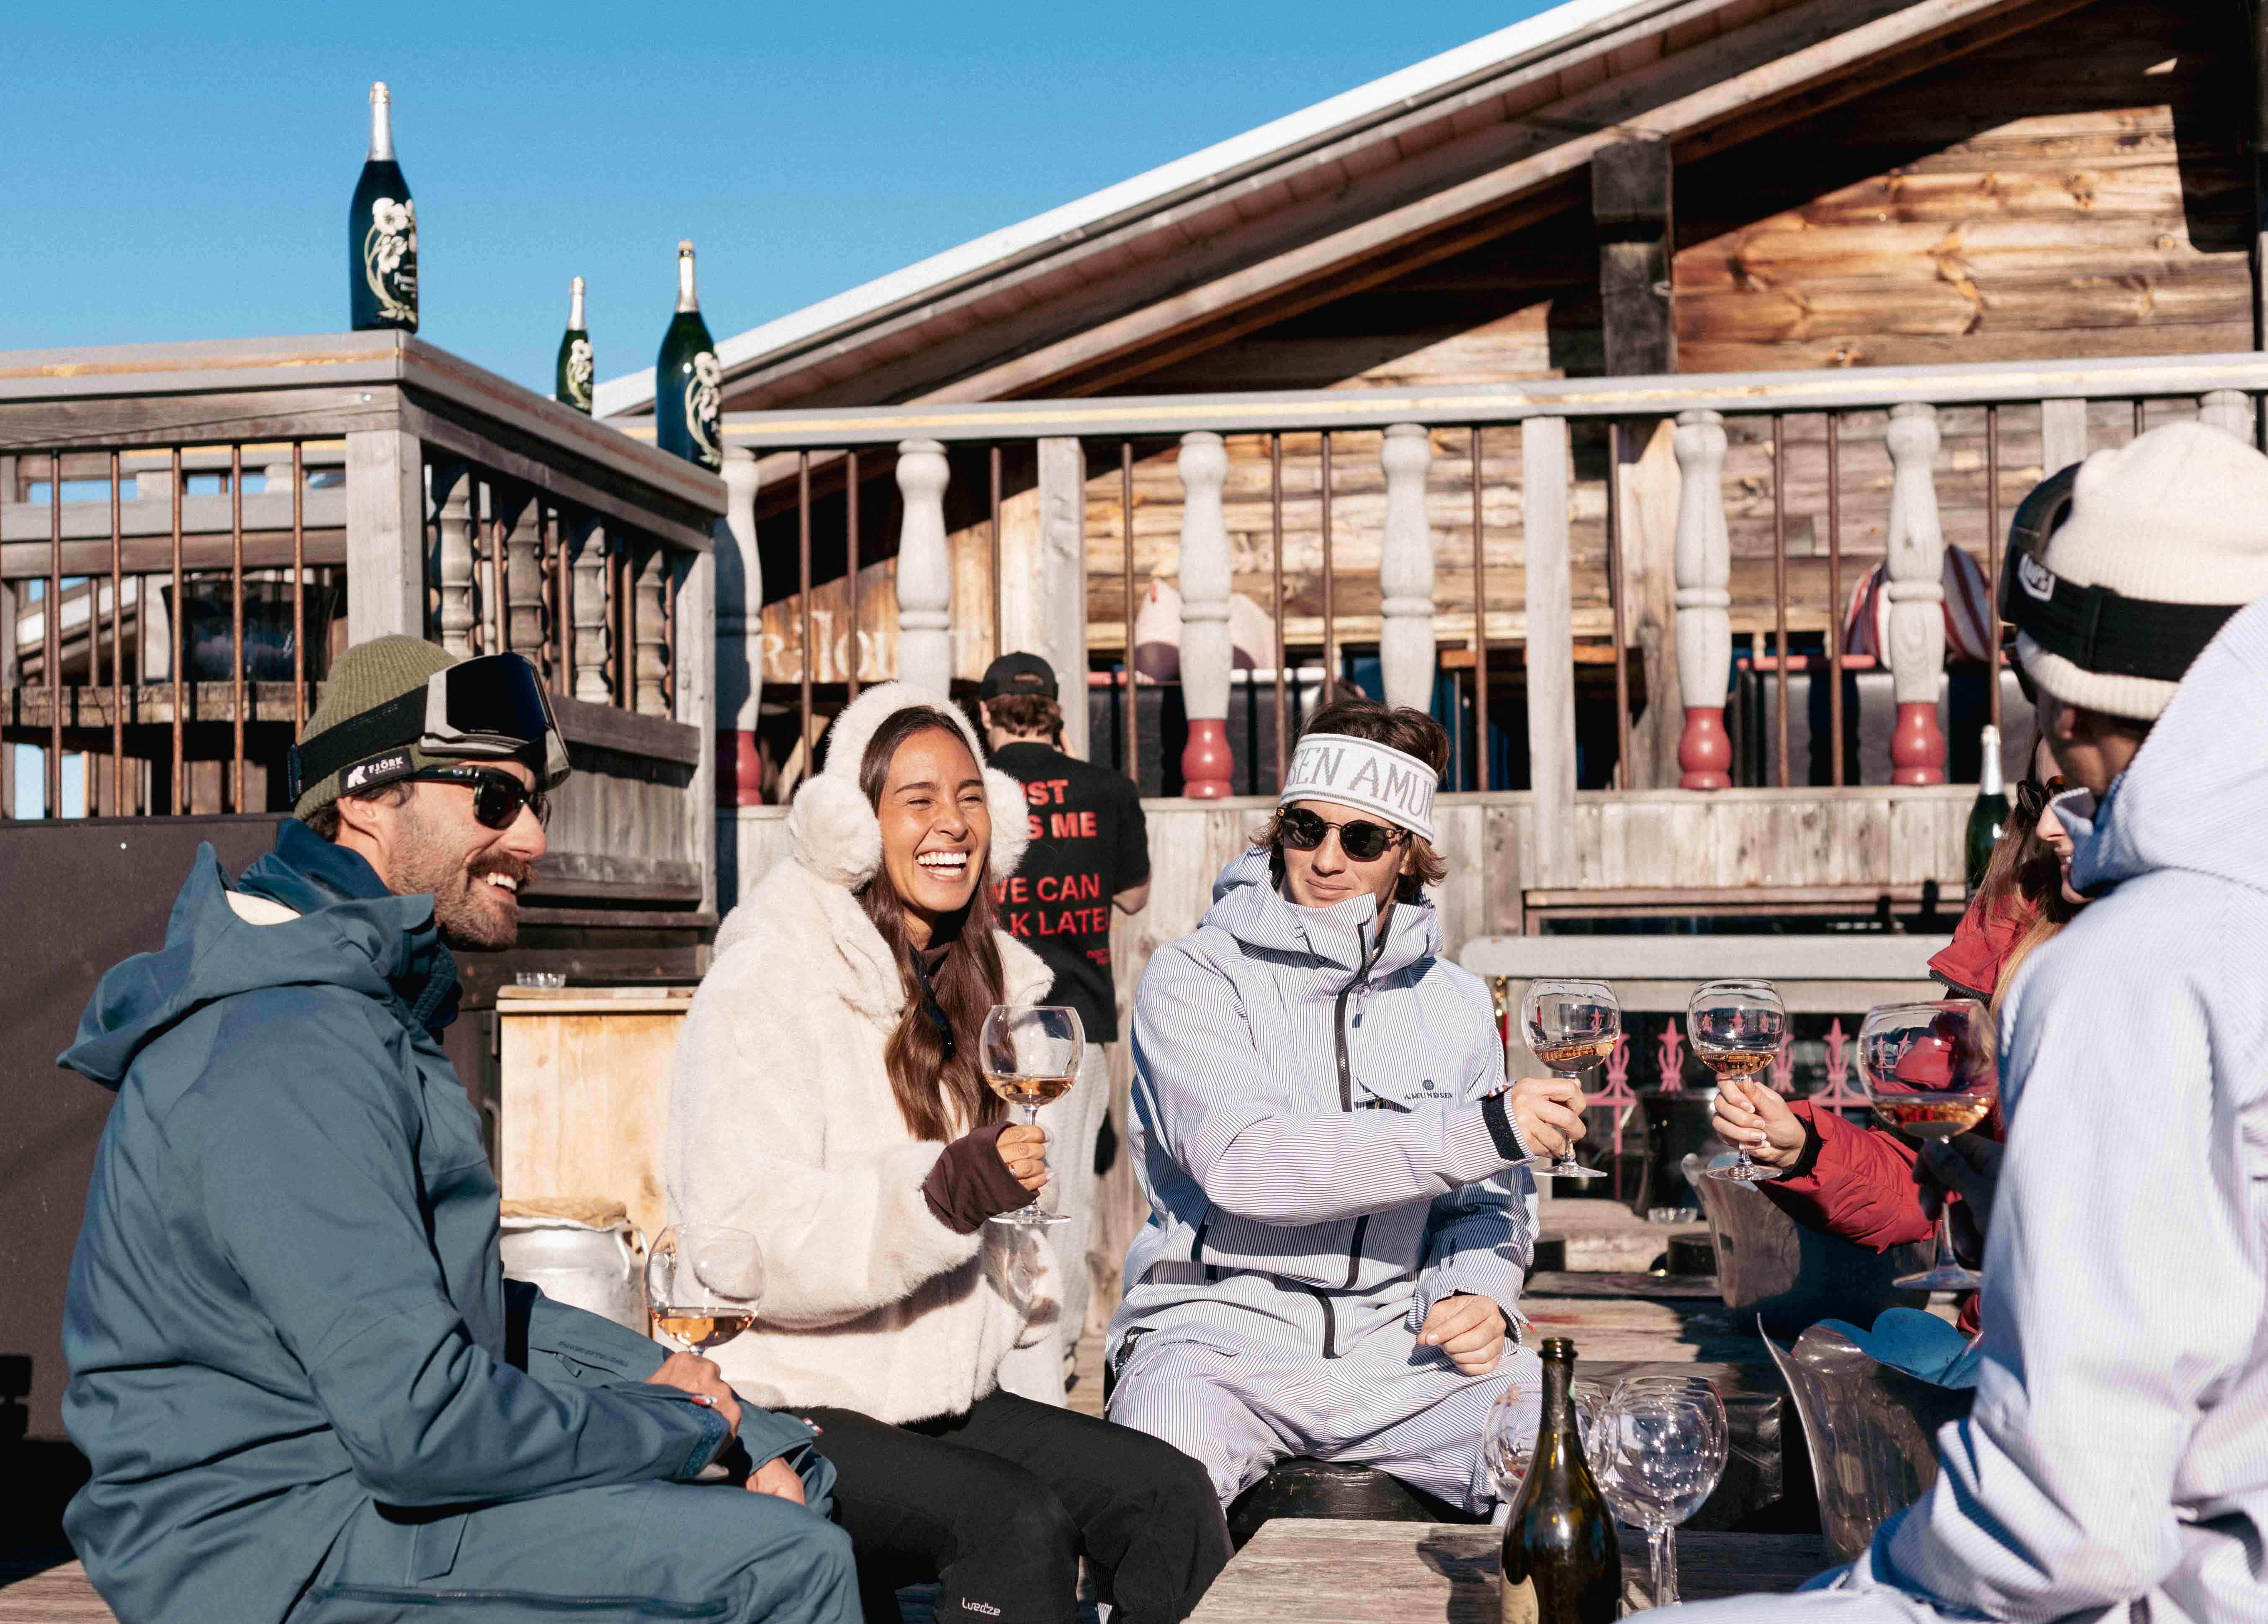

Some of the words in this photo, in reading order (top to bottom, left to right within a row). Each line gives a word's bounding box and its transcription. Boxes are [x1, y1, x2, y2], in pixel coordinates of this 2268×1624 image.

[1050, 811, 1098, 838] ME
[1037, 873, 1100, 902] CAN
[1038, 905, 1110, 937] LATE
